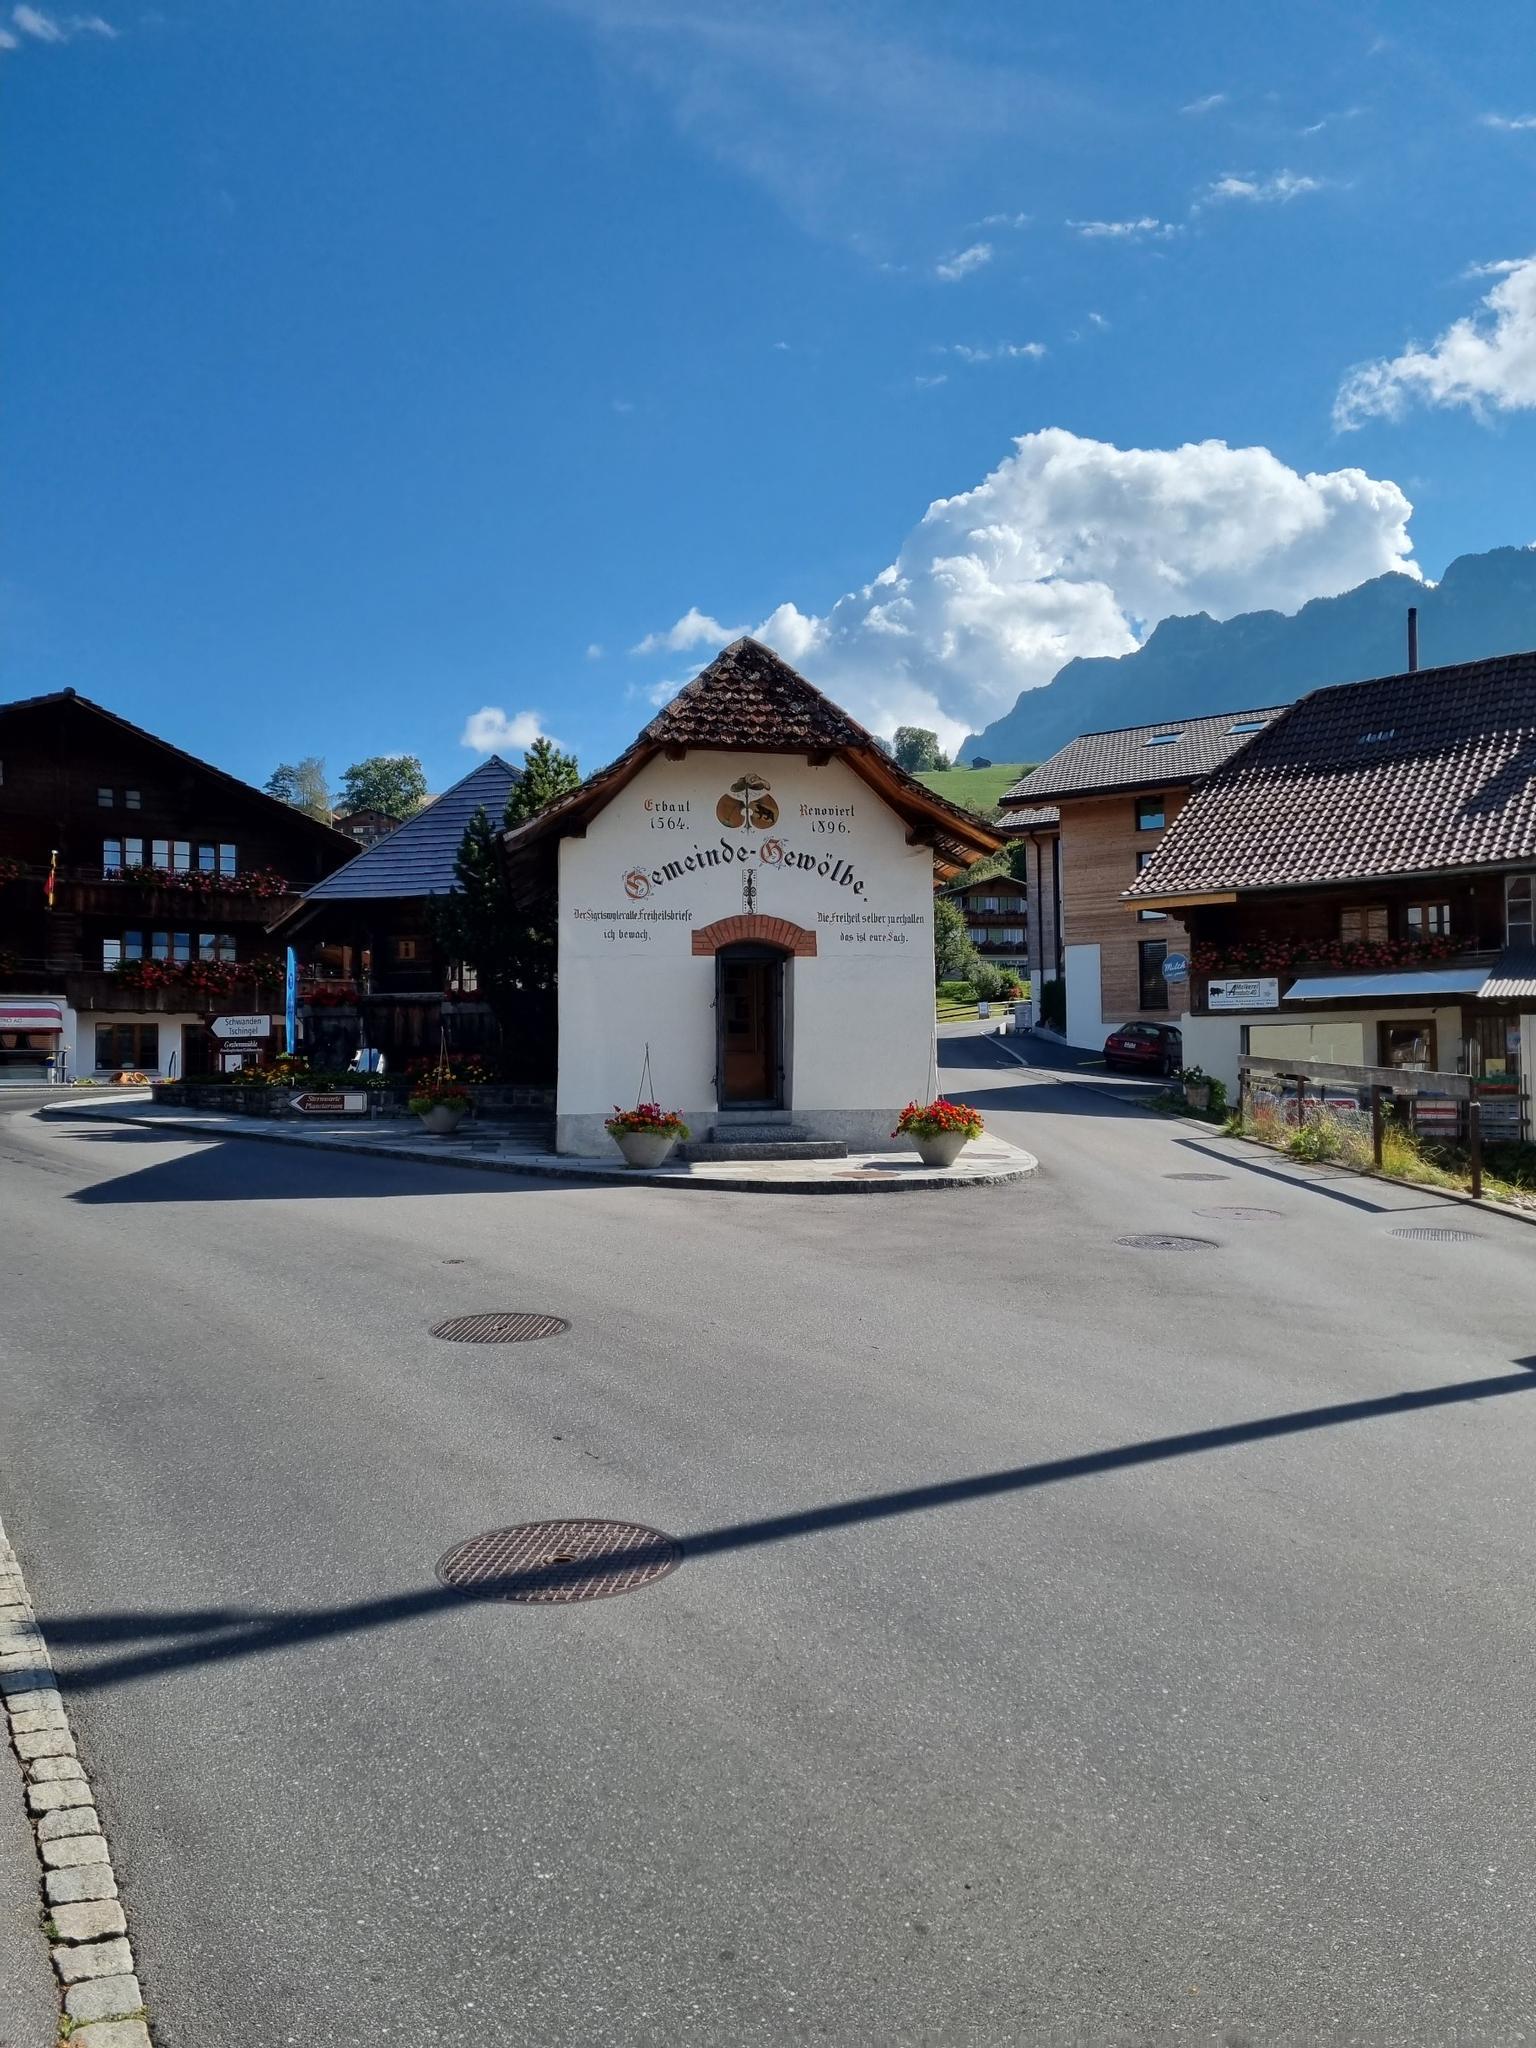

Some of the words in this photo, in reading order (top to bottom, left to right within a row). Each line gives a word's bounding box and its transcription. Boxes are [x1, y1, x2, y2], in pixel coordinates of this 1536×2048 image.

[644, 800, 691, 812] Erbaut
[800, 803, 855, 817] Renoviert
[650, 816, 690, 830] 1564.
[811, 820, 851, 834] 1896.
[573, 908, 586, 919] Der
[817, 912, 829, 923] Die
[829, 912, 861, 926] Freiheit
[862, 912, 886, 924] selber
[603, 929, 616, 941] ich
[840, 931, 854, 942] das
[856, 932, 866, 942] ist
[869, 934, 886, 942] eure
[225, 1017, 262, 1025] Schwanden
[229, 1027, 258, 1035] Tschingel
